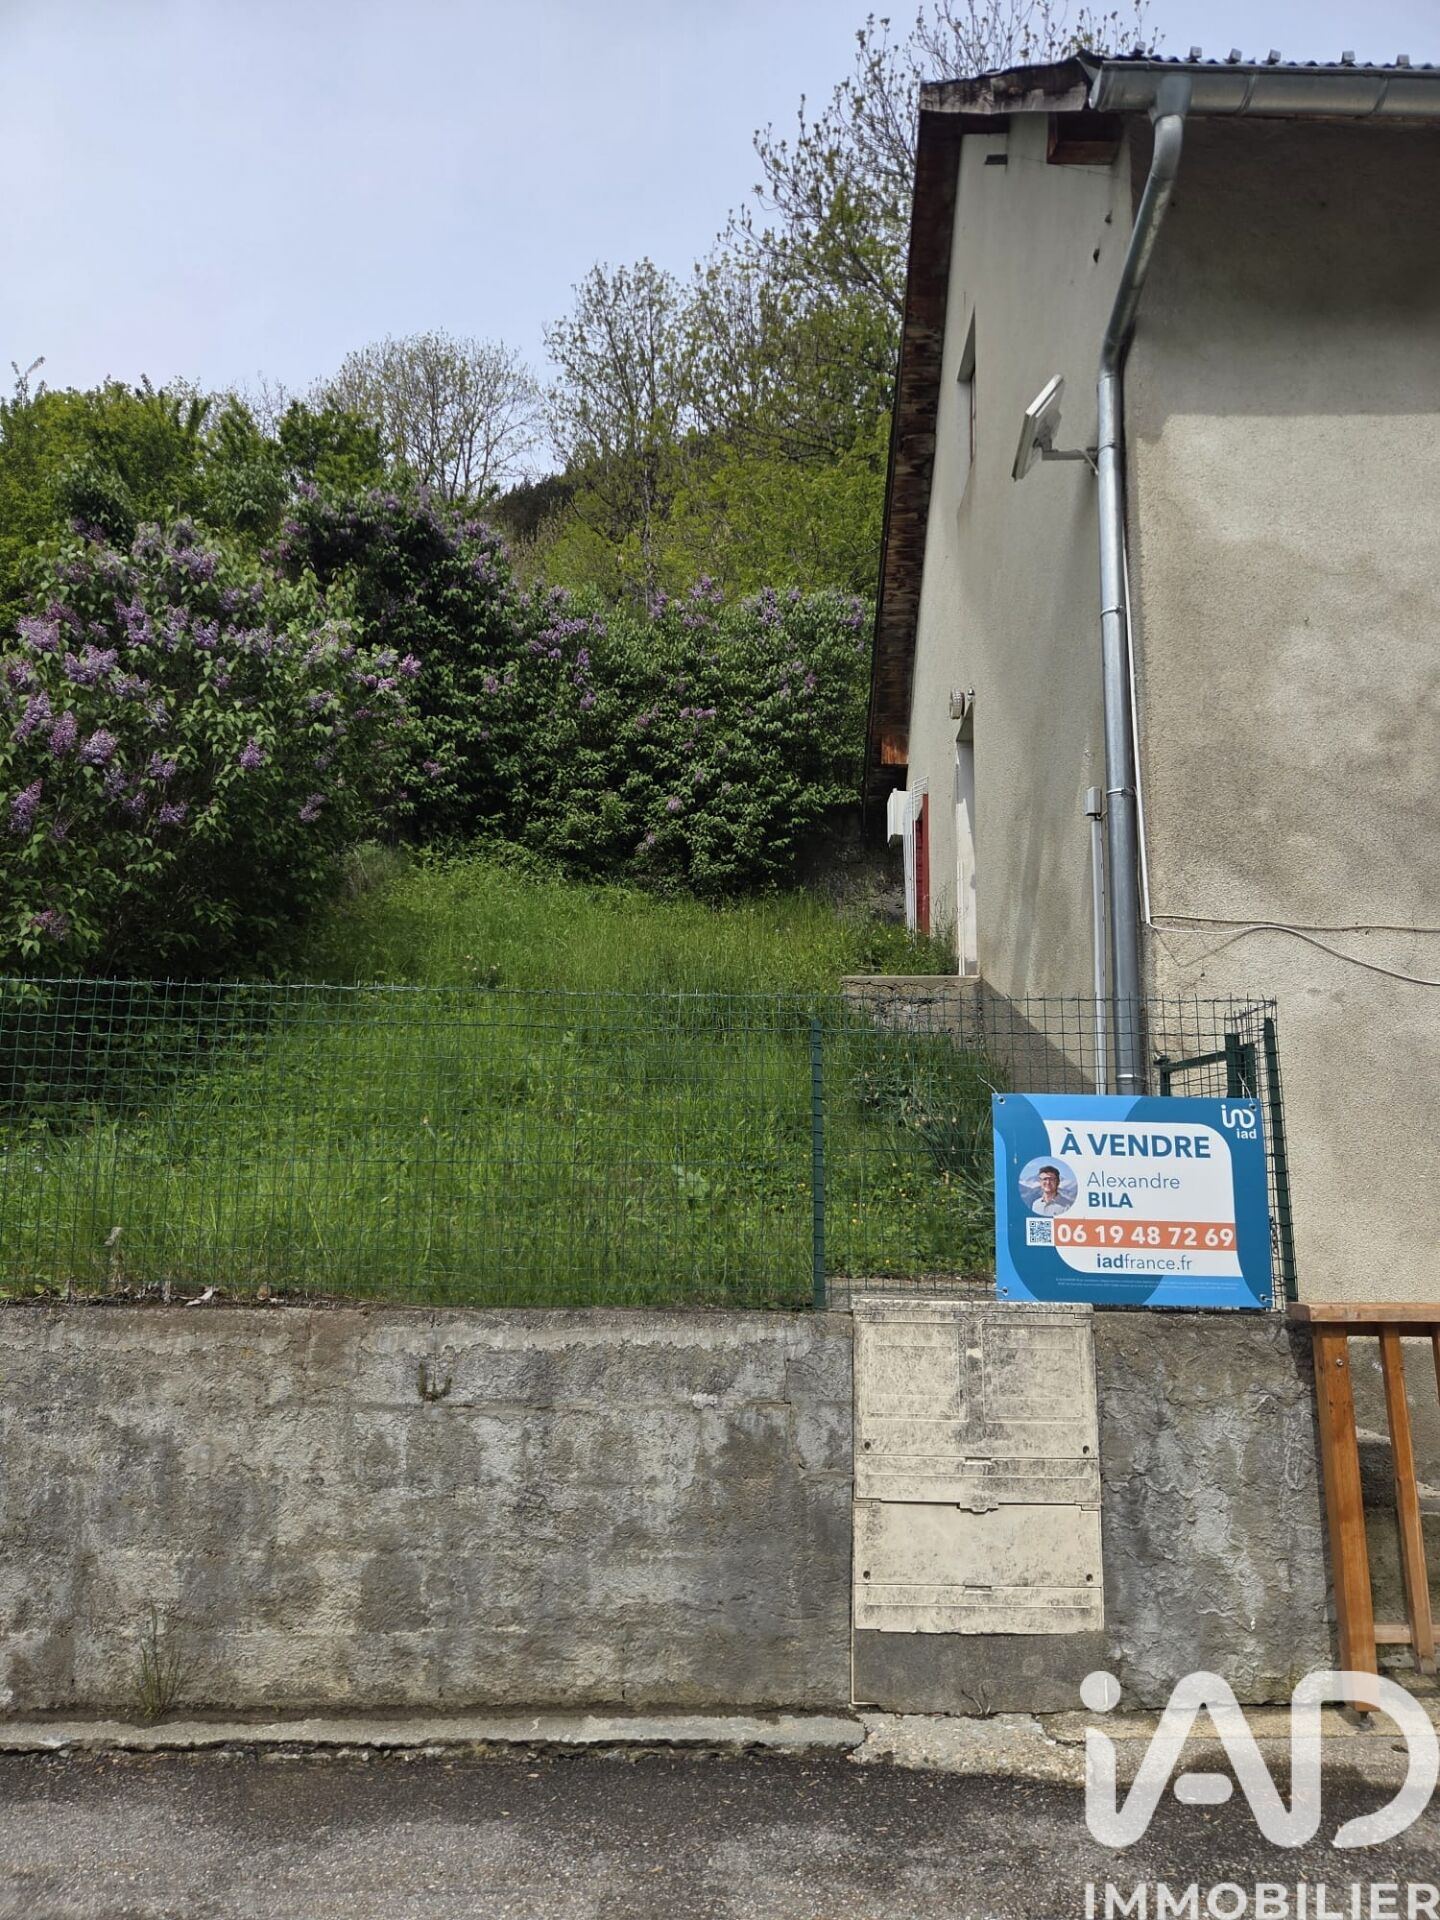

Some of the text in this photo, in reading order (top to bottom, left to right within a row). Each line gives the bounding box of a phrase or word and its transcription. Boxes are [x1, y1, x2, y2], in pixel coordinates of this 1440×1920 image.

[1060, 1127, 1211, 1159] À VENDRE
[1236, 1128, 1257, 1140] iad
[1087, 1171, 1180, 1190] Alexandre
[1088, 1192, 1133, 1209] BILA
[1057, 1224, 1234, 1247] 06 19 48 72 69
[1097, 1253, 1193, 1271] iadfrance.fr
